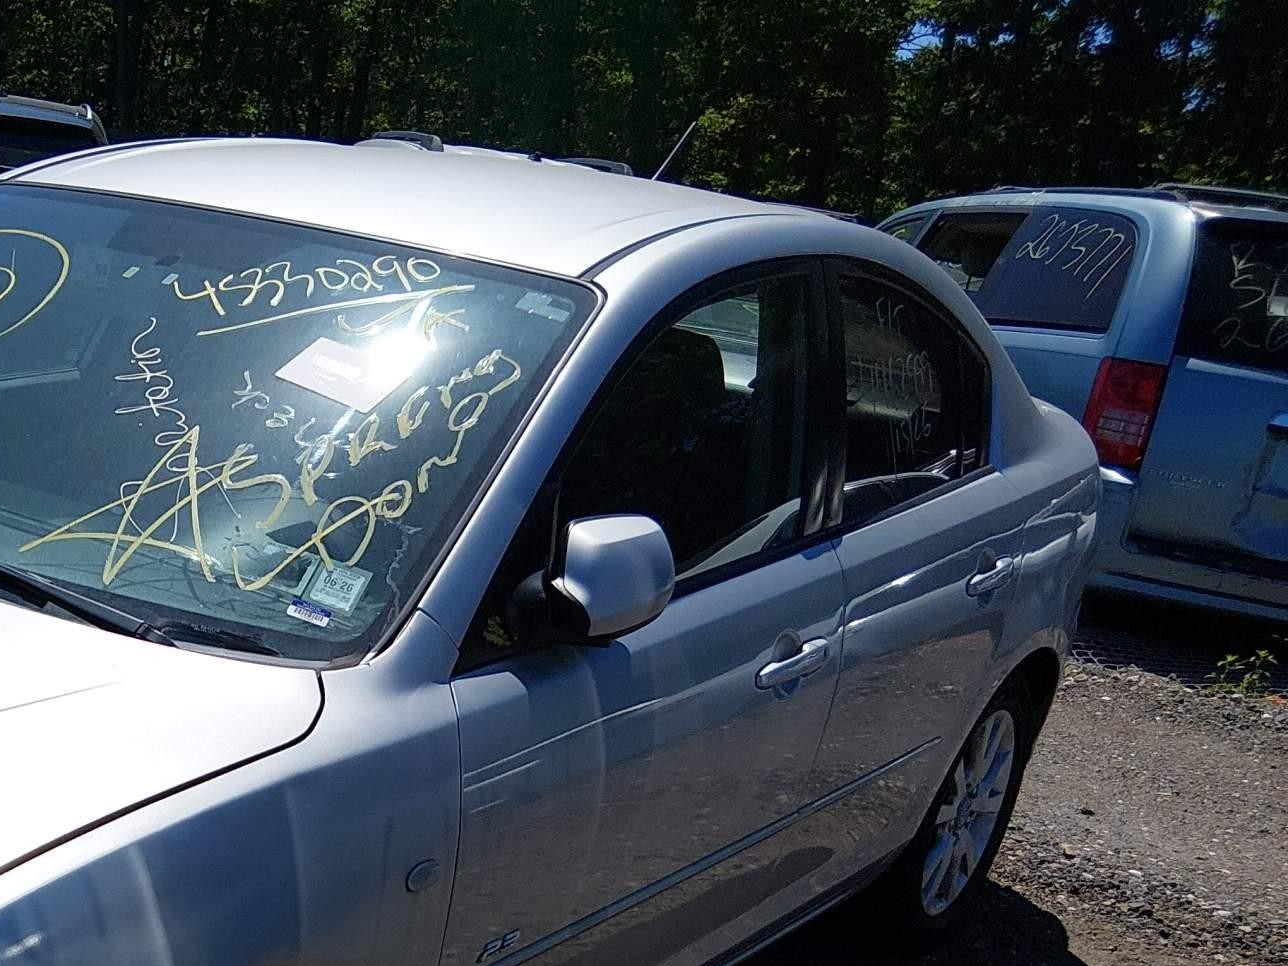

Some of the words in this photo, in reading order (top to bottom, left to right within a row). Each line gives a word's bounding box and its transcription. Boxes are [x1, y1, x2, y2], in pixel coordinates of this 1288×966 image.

[174, 256, 441, 316] 45330290
[323, 575, 338, 587] 06
[339, 580, 355, 593] 26
